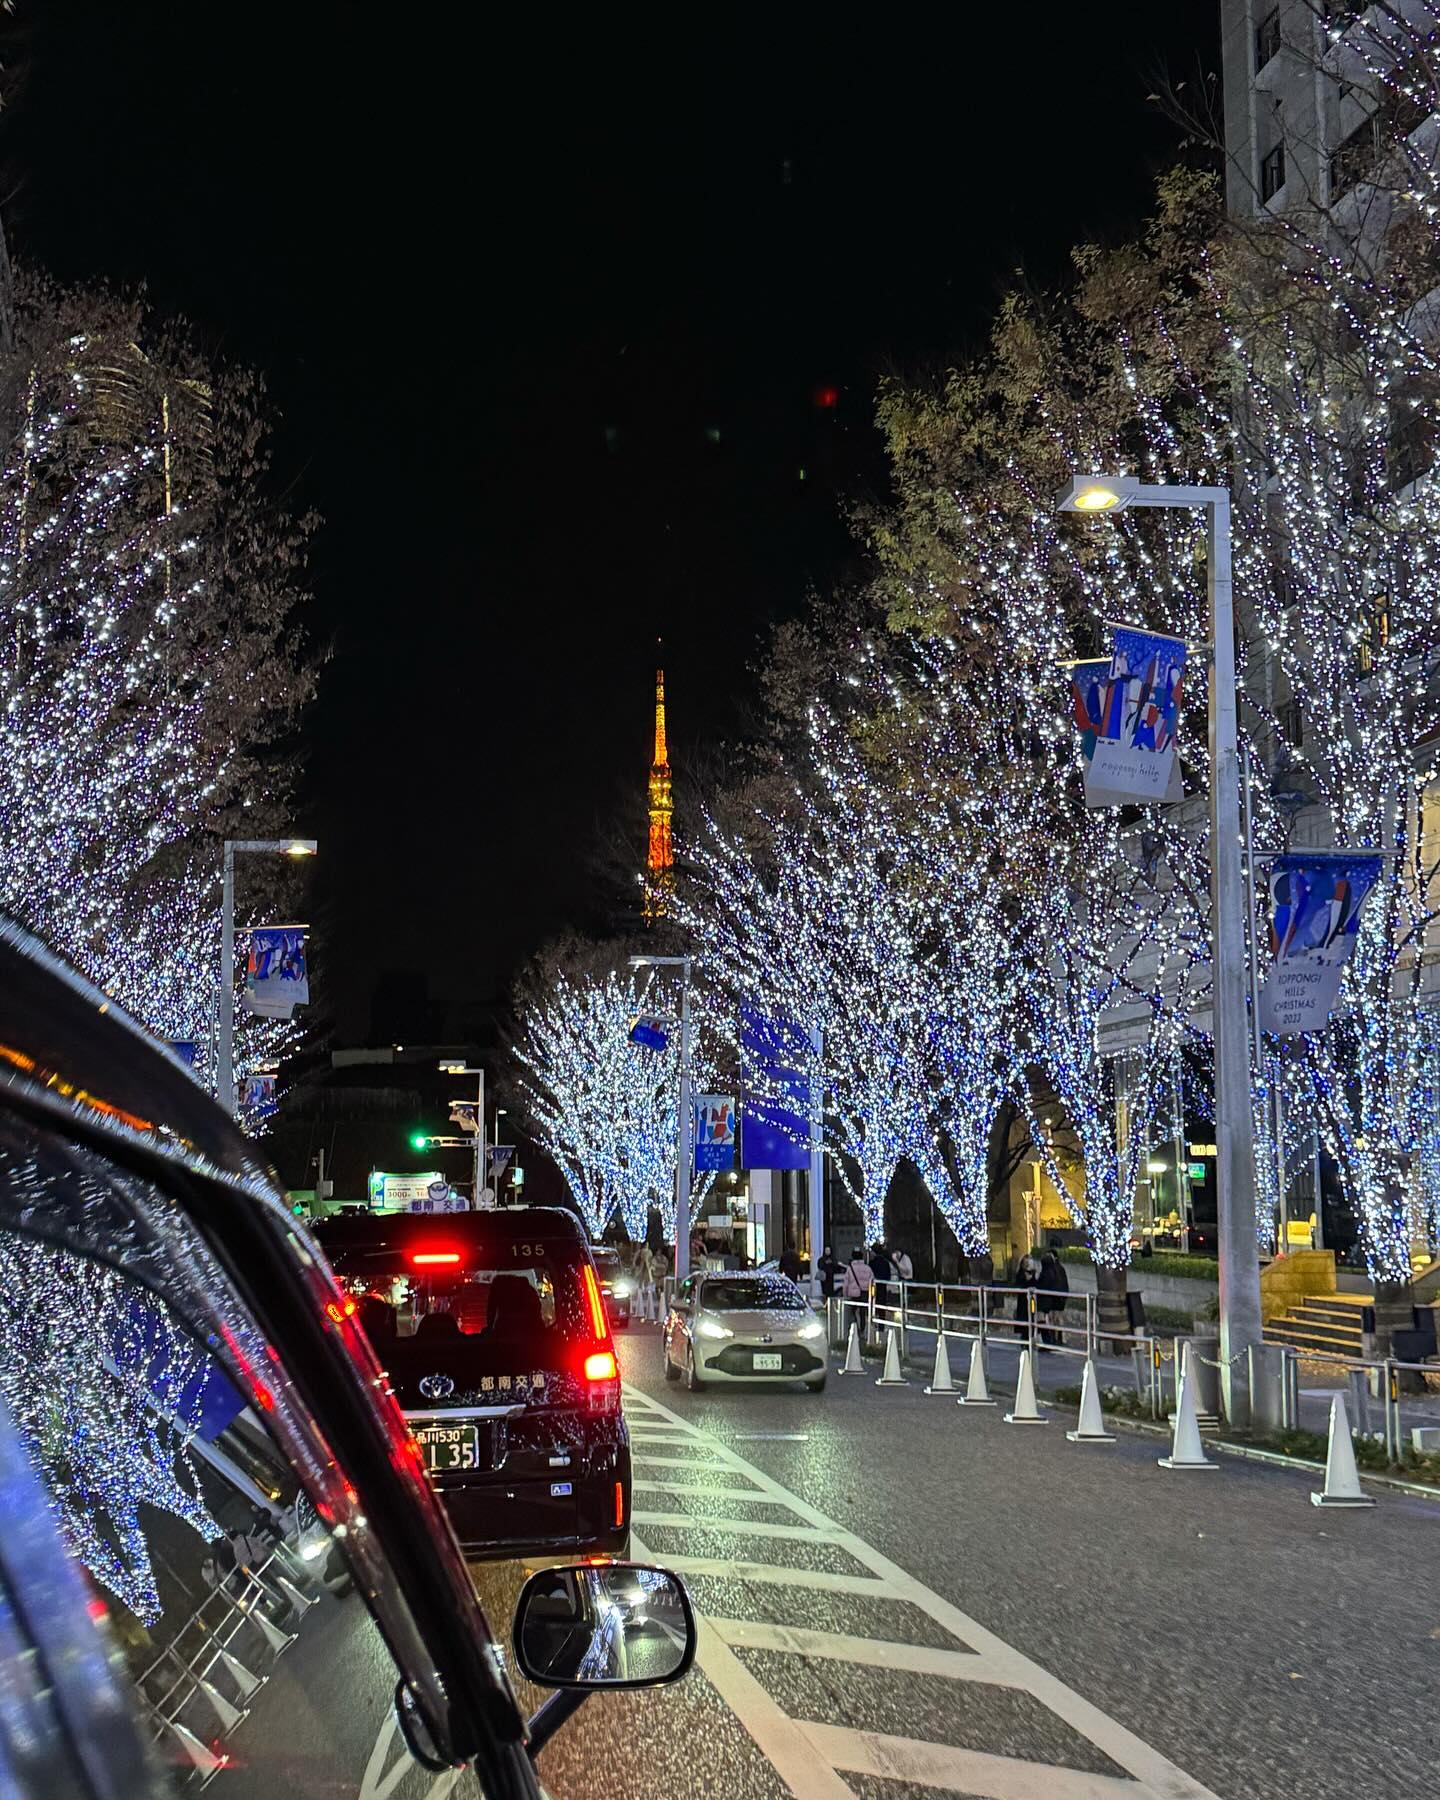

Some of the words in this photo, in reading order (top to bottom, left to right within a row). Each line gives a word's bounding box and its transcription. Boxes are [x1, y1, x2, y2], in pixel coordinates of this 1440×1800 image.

[511, 1244, 545, 1257] 135
[481, 1374, 545, 1392] 都南交通
